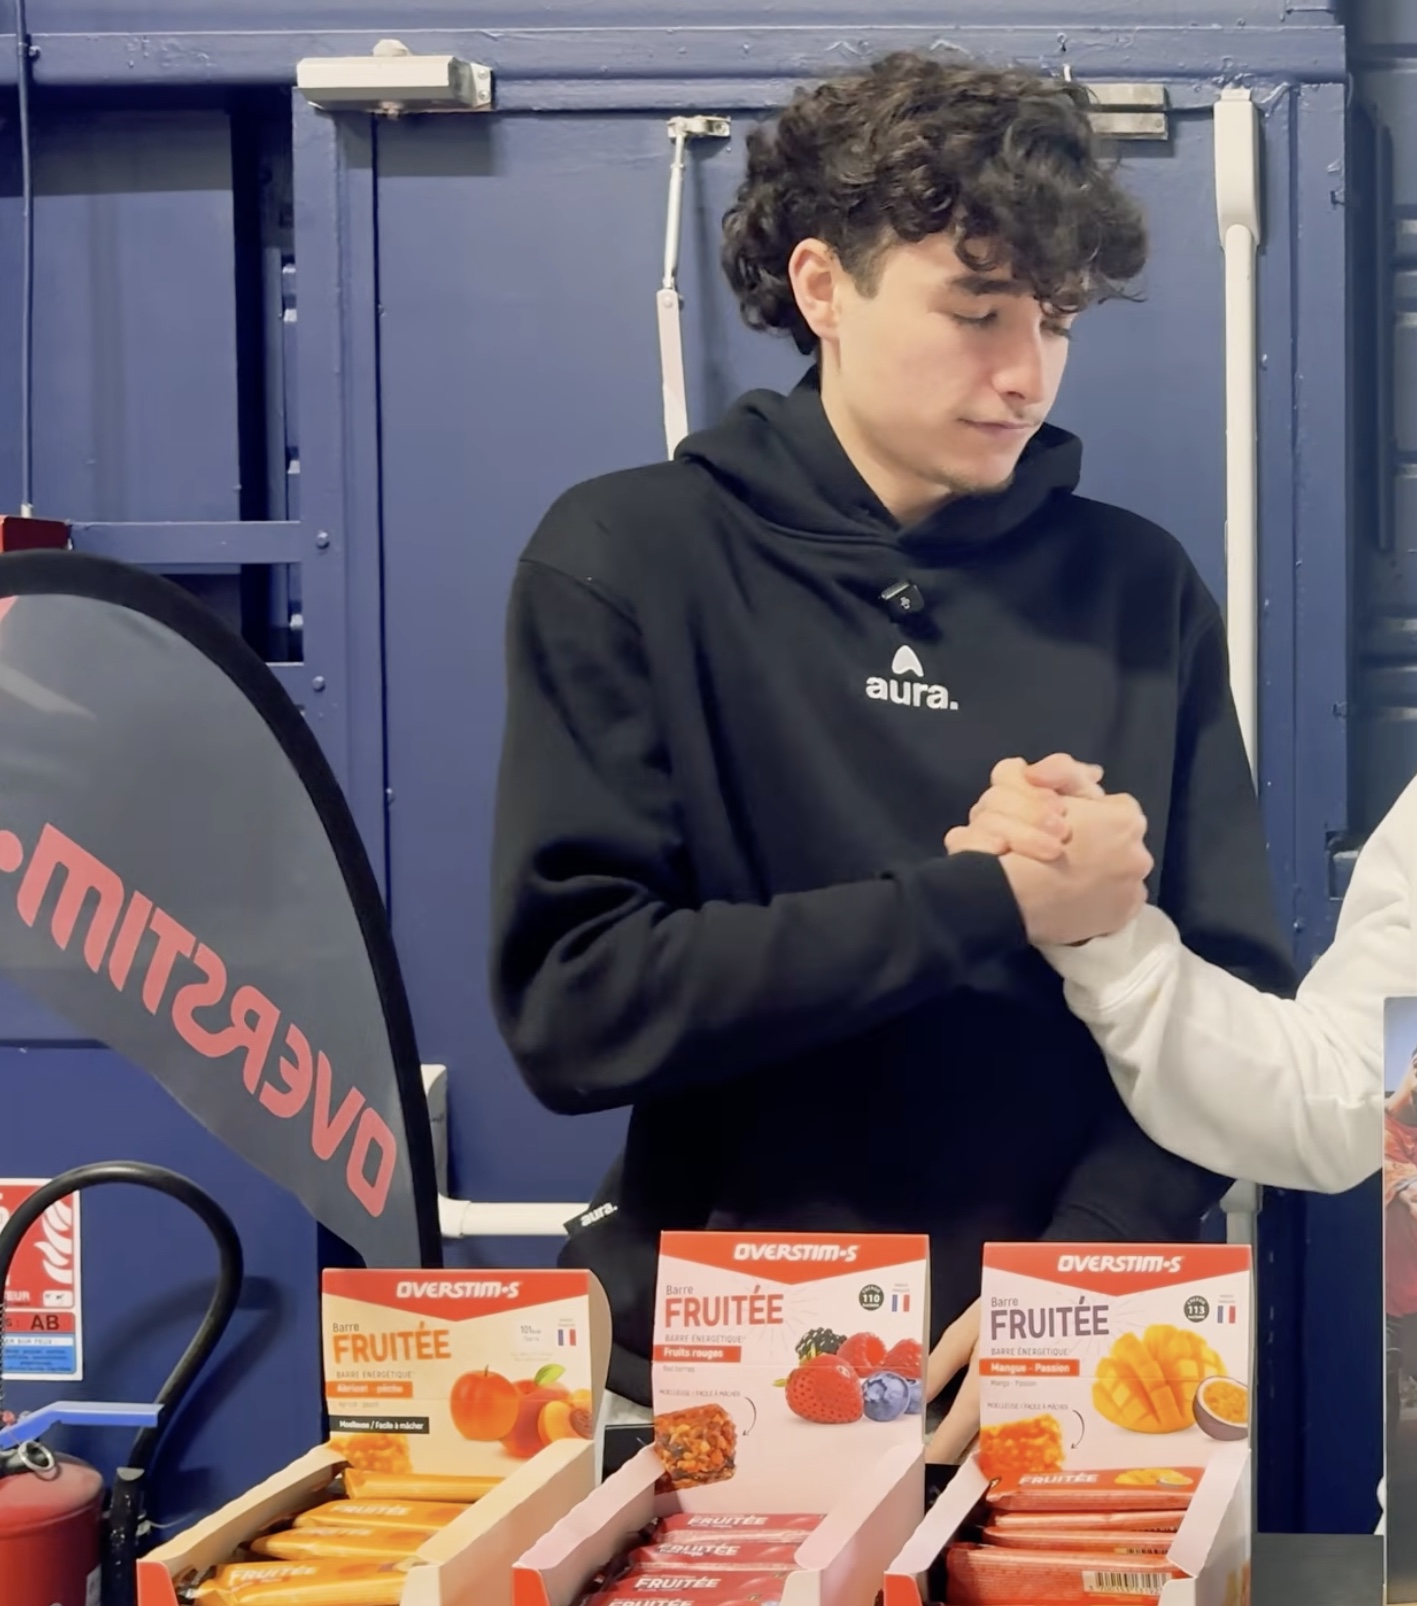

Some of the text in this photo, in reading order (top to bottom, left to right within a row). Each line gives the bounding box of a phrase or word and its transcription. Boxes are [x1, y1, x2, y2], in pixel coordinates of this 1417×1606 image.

[866, 677, 958, 710] aura.
[666, 1285, 693, 1295] Barre
[863, 1294, 880, 1303] 110
[991, 1297, 1018, 1307] Barre
[665, 1285, 784, 1328] FRUITÉE
[30, 1314, 60, 1331] AB
[991, 1296, 1109, 1340] FRUITÉE
[332, 1323, 360, 1333] Barre
[333, 1321, 451, 1364] FRUITÉE
[665, 1334, 689, 1342] BARRE
[664, 1347, 723, 1360] Fruits rouges
[991, 1347, 1014, 1356] BARRE
[991, 1363, 1027, 1374] Mangue
[1034, 1362, 1070, 1373] Passion
[336, 1371, 359, 1379] BARRE
[375, 1421, 393, 1430] Facile
[400, 1421, 424, 1430] mâcher
[1019, 1472, 1099, 1485] FRUITÉE
[331, 1504, 412, 1516] FRUITÉE
[688, 1515, 768, 1525] FRUITÉE
[659, 1543, 740, 1556] FRUITÉE
[229, 1566, 319, 1586] FRUITÉE
[635, 1576, 721, 1588] FRUITÉE
